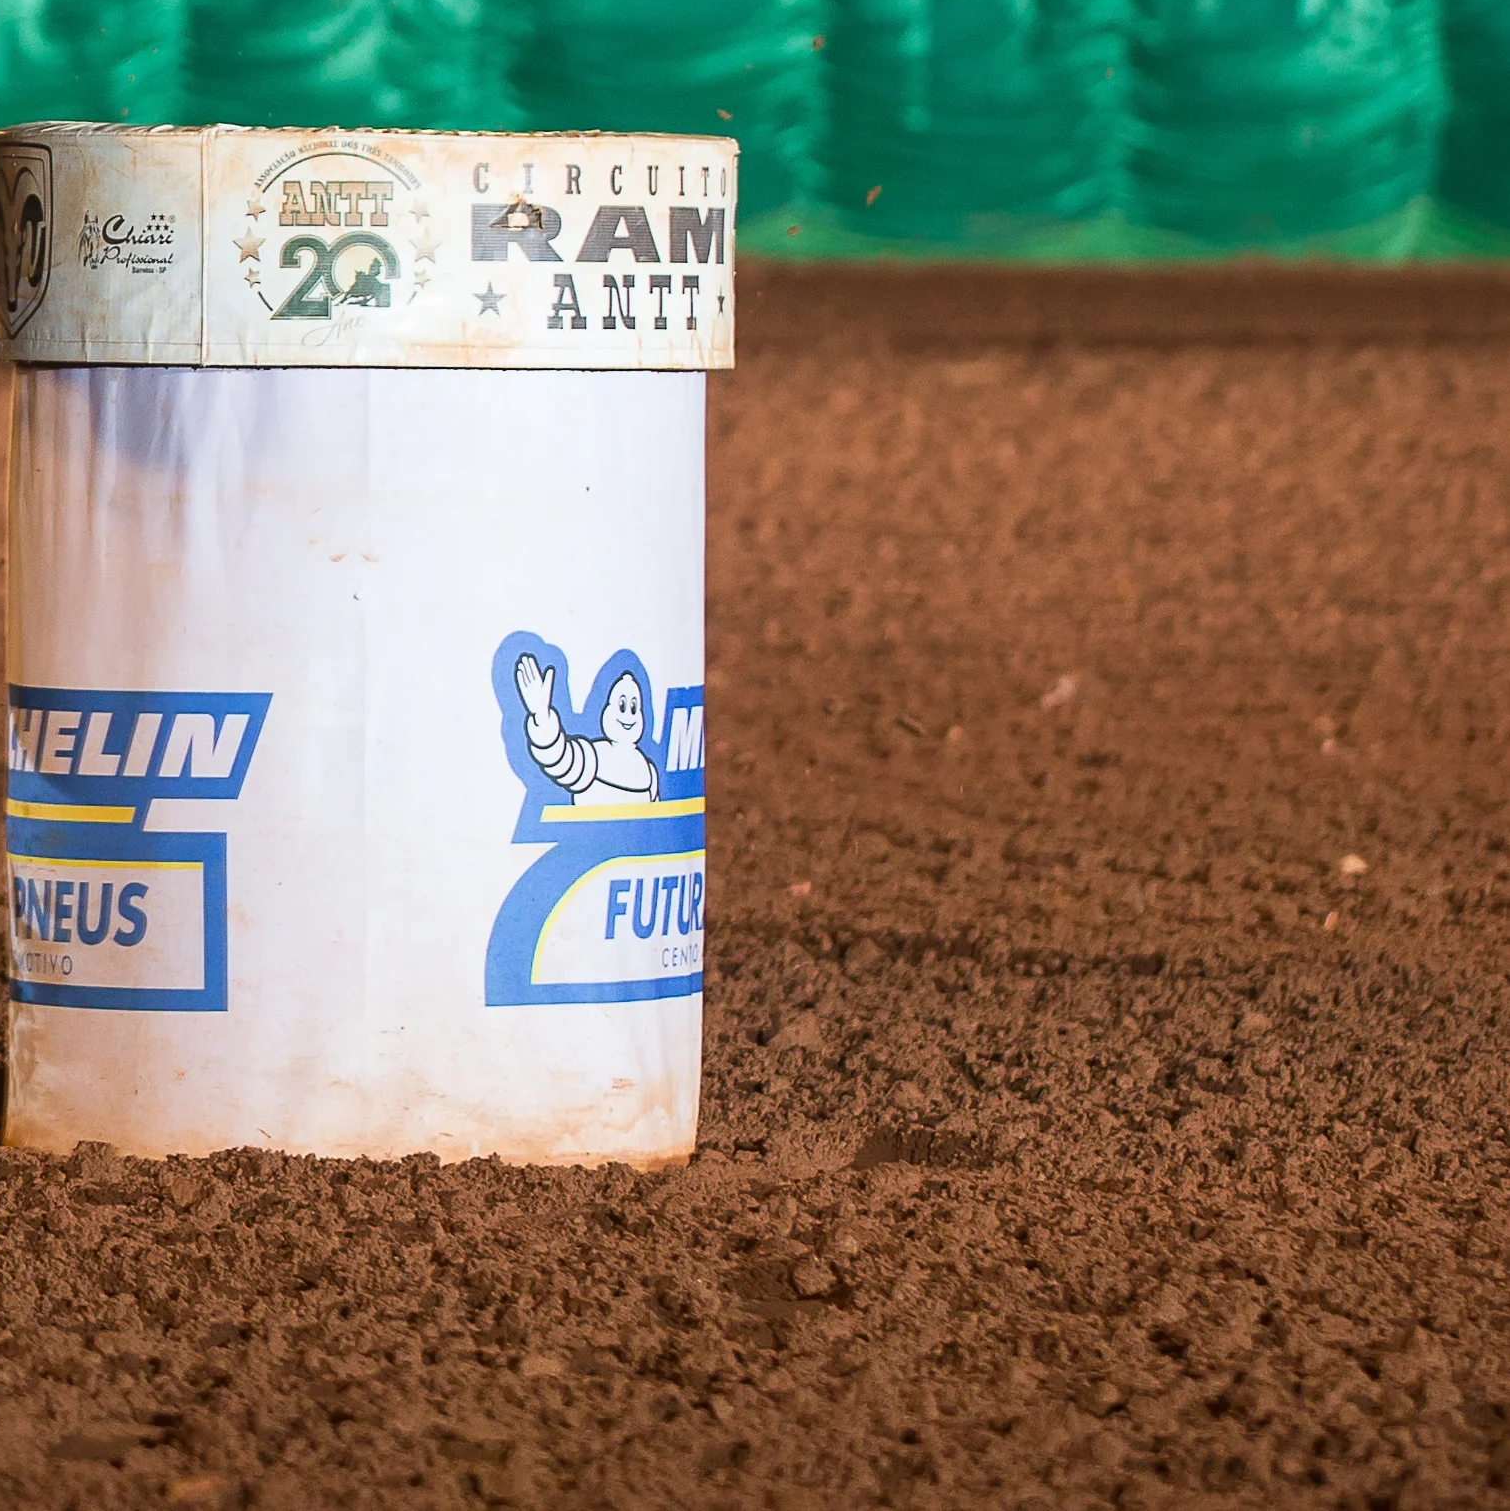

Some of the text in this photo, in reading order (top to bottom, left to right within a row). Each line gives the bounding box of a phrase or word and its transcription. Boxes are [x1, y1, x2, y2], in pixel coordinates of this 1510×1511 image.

[279, 180, 394, 227] ANTT
[472, 162, 727, 198] CIRCUITO
[101, 213, 174, 245] Chiari
[470, 202, 726, 265] RAM
[99, 245, 174, 269] Profissional
[546, 273, 701, 331] ANTT
[14, 876, 149, 948] PNEUS
[605, 871, 704, 940] FUTUR
